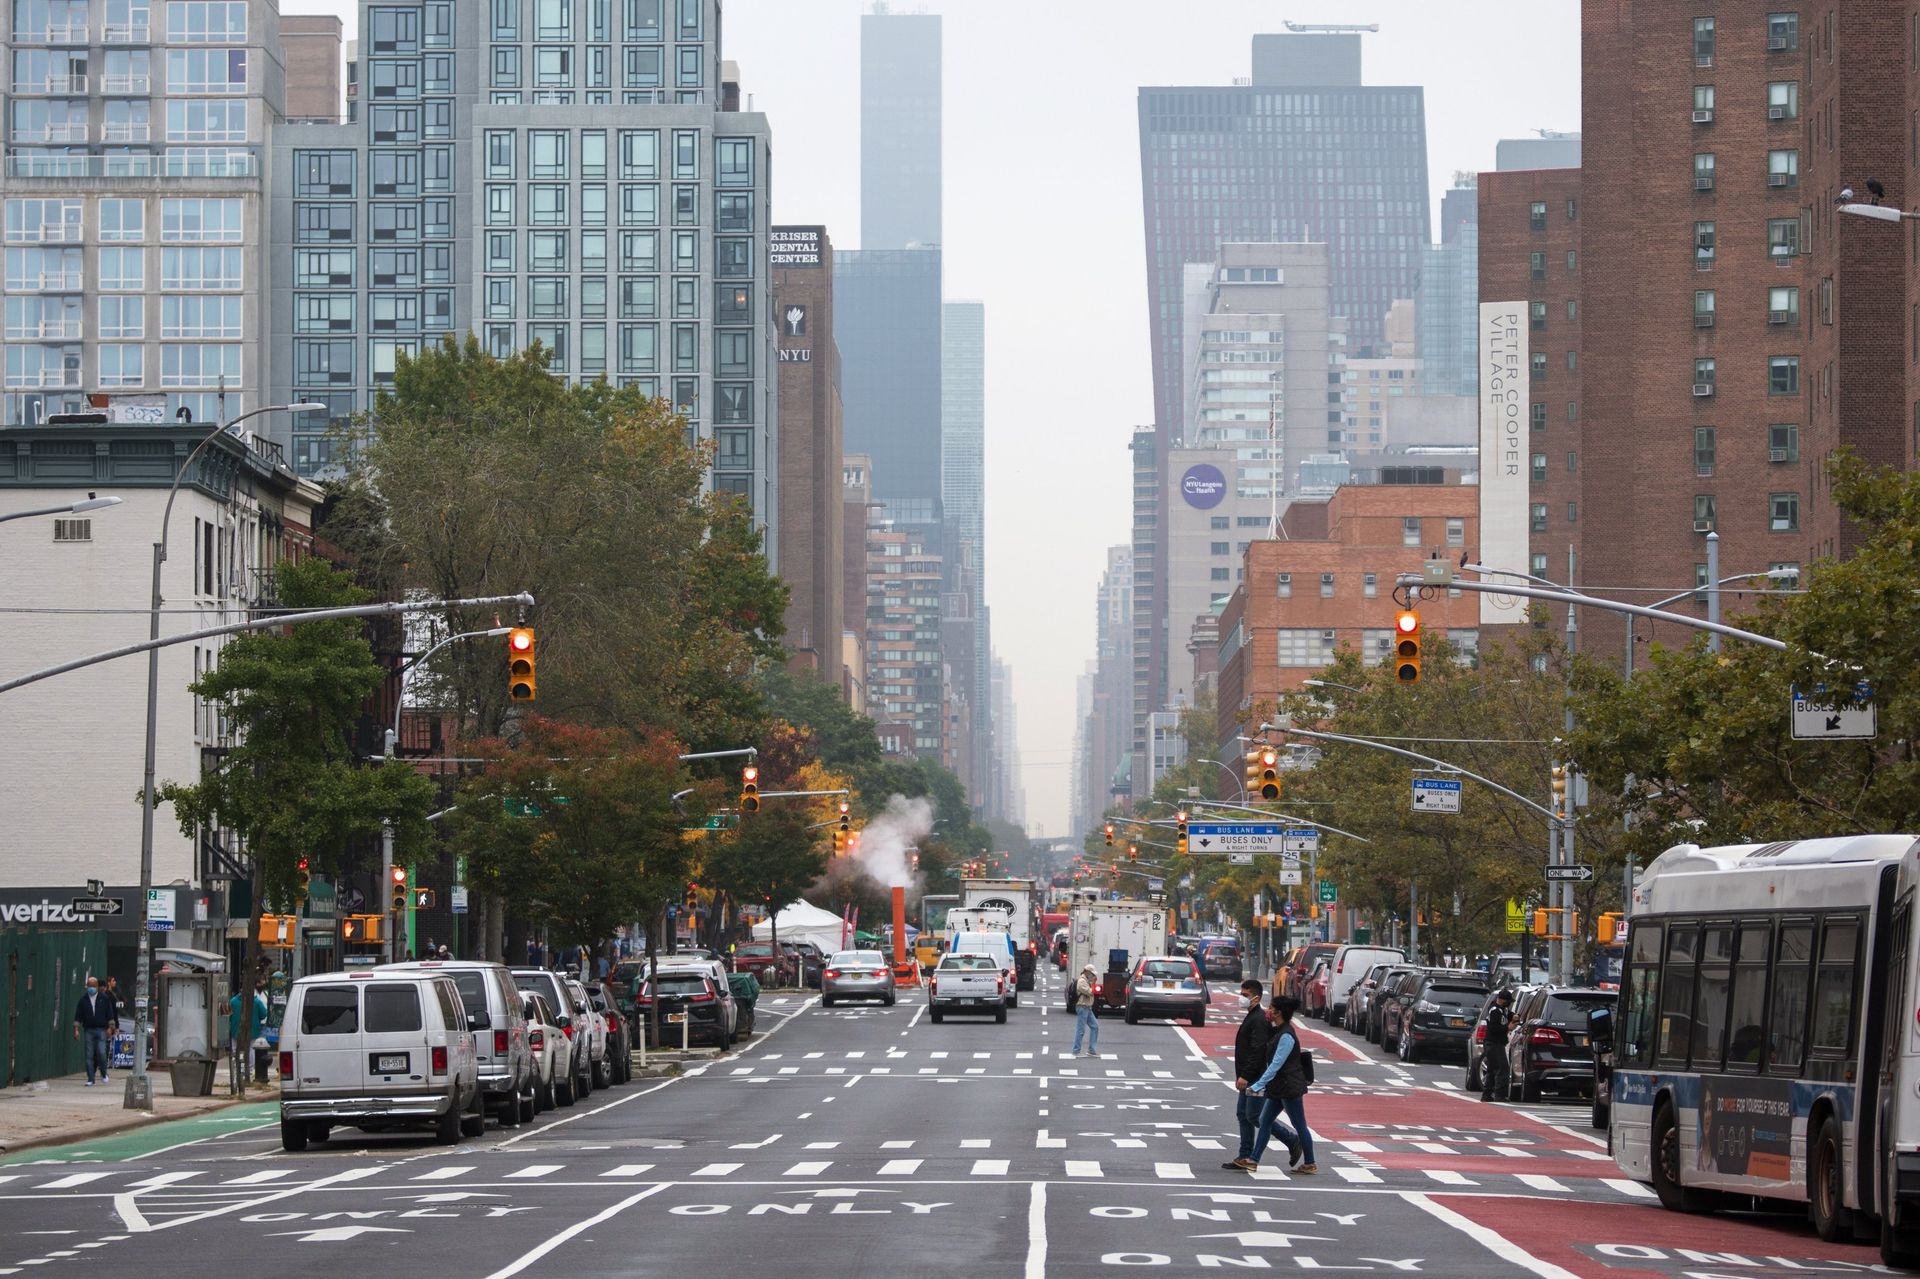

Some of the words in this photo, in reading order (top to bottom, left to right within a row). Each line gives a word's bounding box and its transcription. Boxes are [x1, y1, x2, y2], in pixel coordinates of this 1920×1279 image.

[771, 232, 818, 241] KRISER
[771, 243, 818, 252] DENTAL
[770, 254, 818, 263] CENTER
[1506, 314, 1518, 380] PETER
[780, 349, 810, 361] NYU
[1490, 316, 1503, 404] VILLAGE
[1506, 389, 1519, 477] COOPER
[1220, 836, 1248, 844] BUSES
[1251, 836, 1273, 844] ONLY
[1550, 869, 1563, 877] ONE
[1572, 869, 1586, 877] WAY
[1717, 1097, 1724, 1111] DO
[1736, 1098, 1746, 1112] FOR
[1746, 1098, 1767, 1114] YOURSELF
[1768, 1100, 1777, 1115] THIS
[1347, 1123, 1514, 1135] ONLY
[1389, 1134, 1536, 1145] BUS
[240, 1206, 542, 1221] ONLY
[668, 1202, 954, 1215] ONLY
[1089, 1206, 1367, 1225] ONLY
[1101, 1252, 1425, 1271] ONLY
[1595, 1243, 1906, 1275] ONLY
